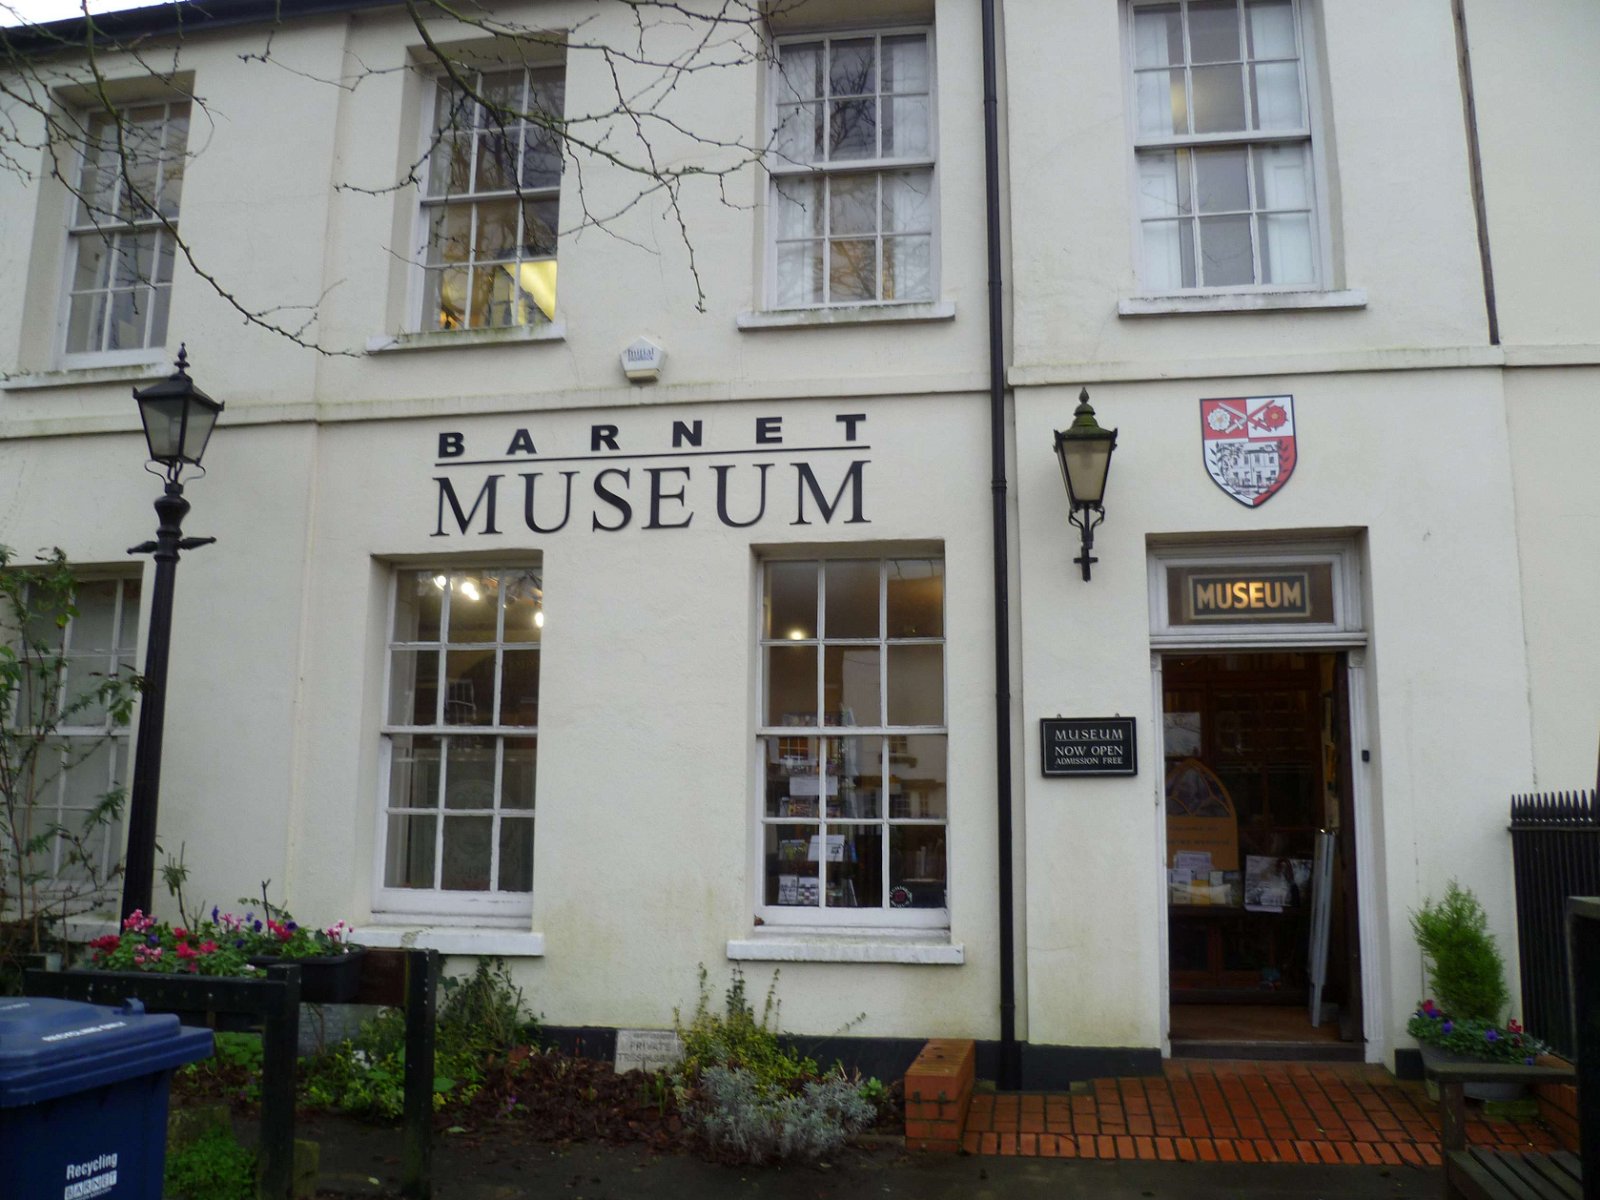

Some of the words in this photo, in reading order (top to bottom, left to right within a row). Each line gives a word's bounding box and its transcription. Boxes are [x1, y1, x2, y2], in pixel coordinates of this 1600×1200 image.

[438, 414, 867, 458] BARNET
[430, 460, 872, 537] MUSEUM
[1196, 581, 1301, 609] MUSEUM
[1055, 729, 1123, 740] MUSEUM
[1055, 746, 1087, 756] NOW
[1091, 745, 1123, 756] OPEN
[1056, 757, 1099, 765] ADMISSION
[1103, 757, 1123, 765] FREE
[66, 1153, 118, 1180] Recycling
